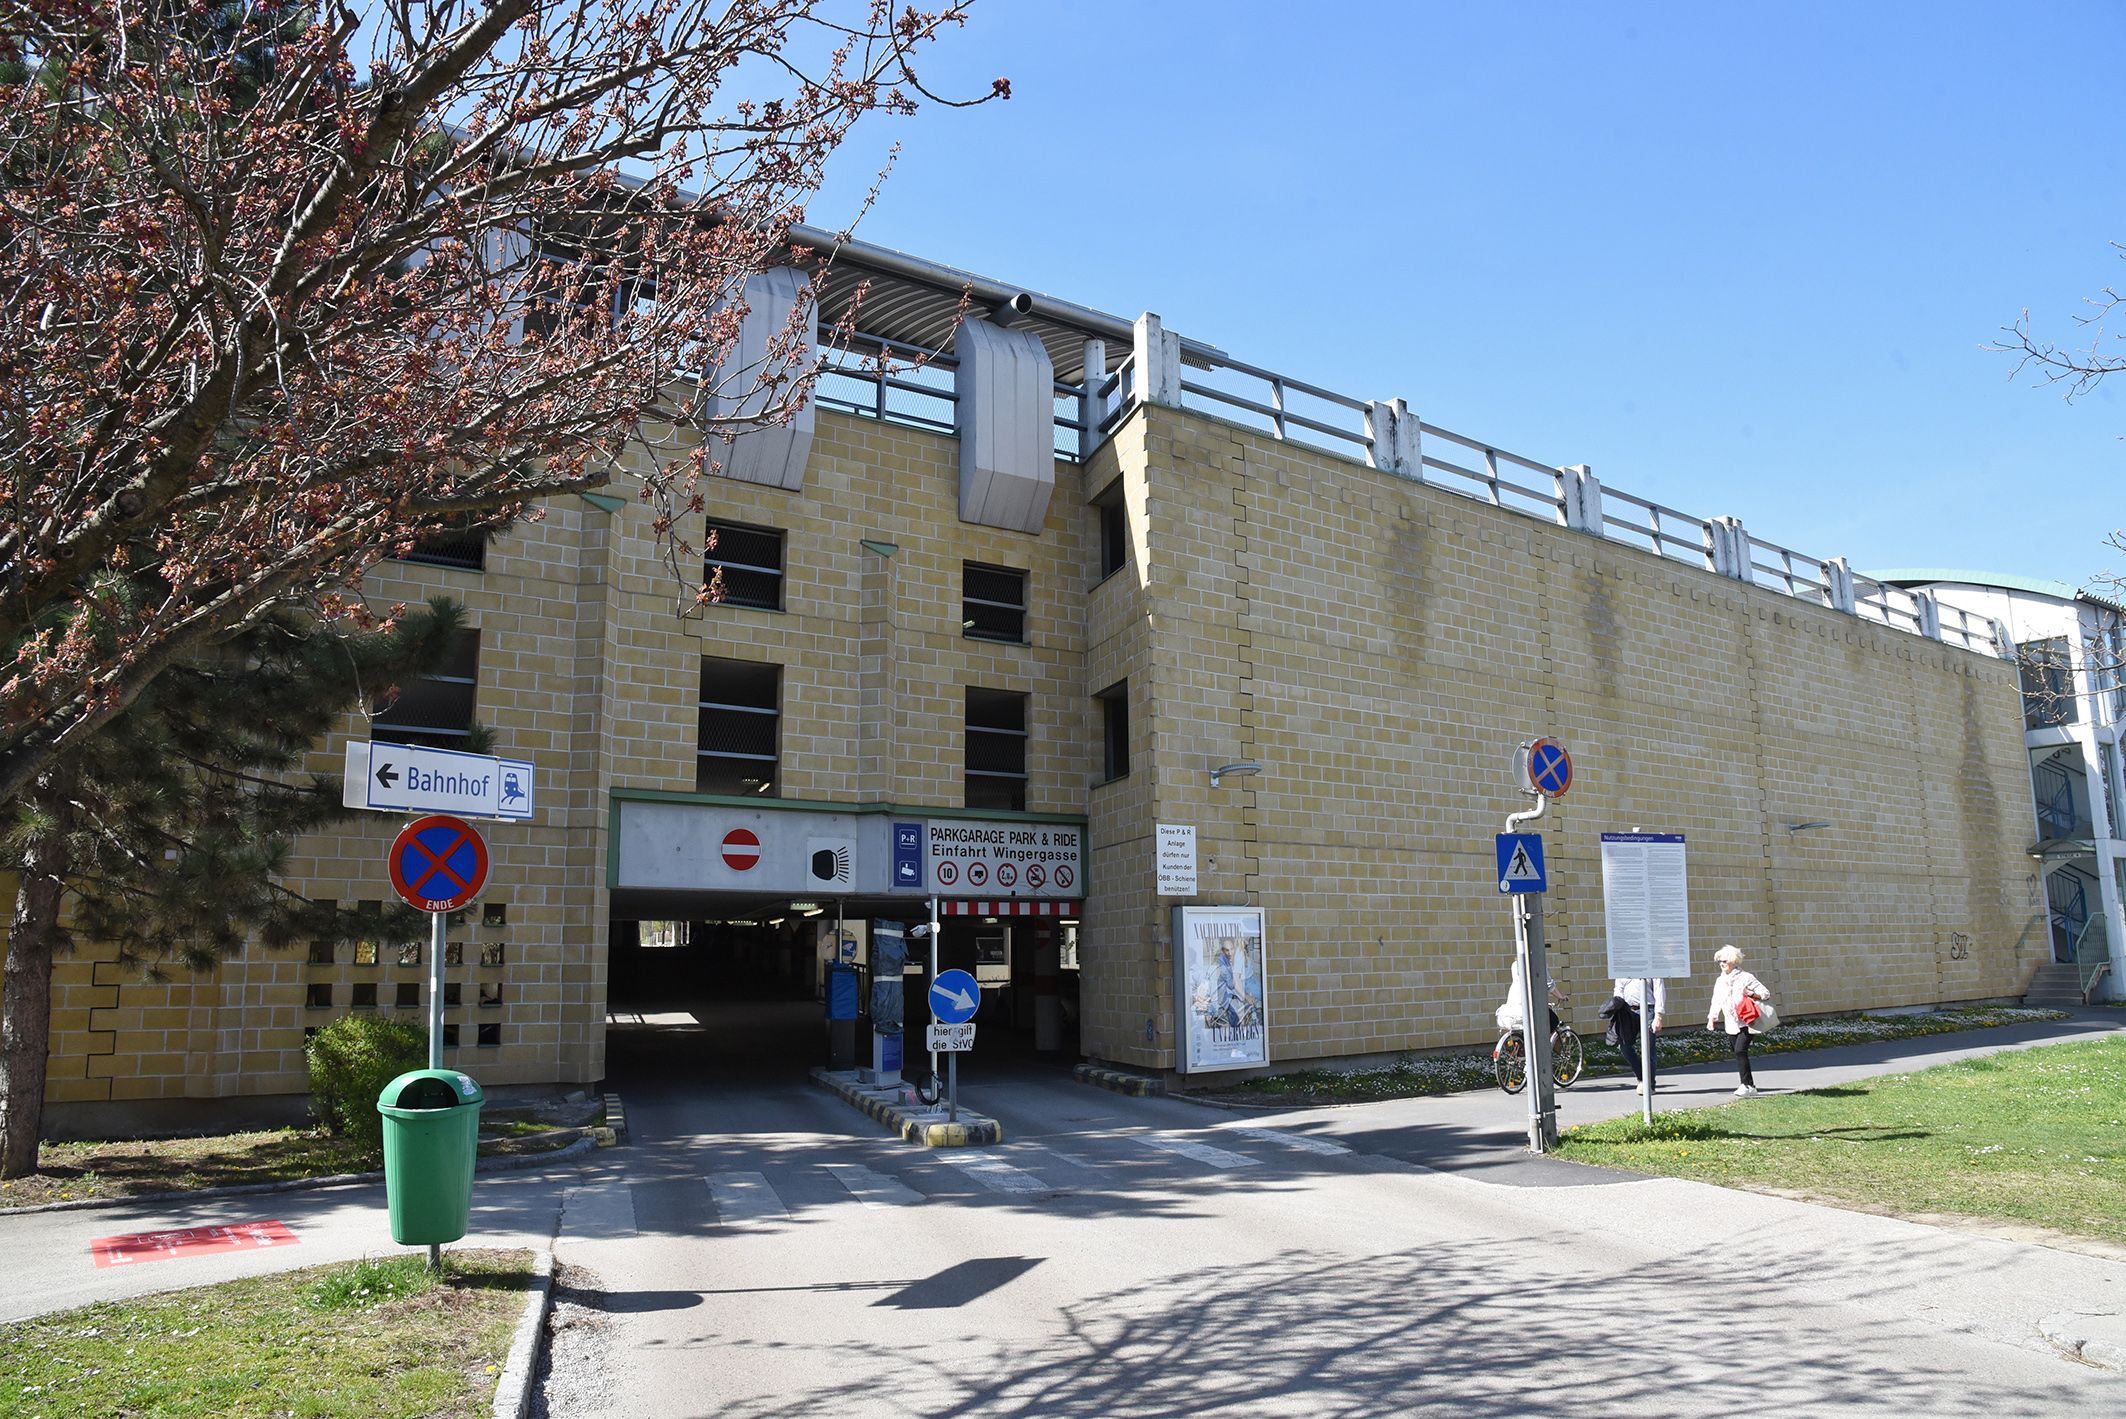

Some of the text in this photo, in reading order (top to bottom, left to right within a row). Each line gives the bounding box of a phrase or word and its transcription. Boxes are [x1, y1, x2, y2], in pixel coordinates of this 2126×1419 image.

[408, 766, 490, 797] Bahnhof
[901, 834, 916, 843] P+R
[931, 827, 1077, 847] PARKGARAGE PARK & RIDE
[1603, 834, 1654, 842] Nutzungsbedingungen
[1167, 840, 1185, 848] Anlage
[932, 844, 1077, 862] Einfahrt Wingergasse
[943, 868, 952, 879] 10
[1158, 874, 1171, 882] ÖBB
[425, 899, 455, 911] ENDE
[934, 1025, 972, 1037] hier gilt
[1212, 1022, 1260, 1042] UNTERWEGS
[932, 1040, 947, 1049] die
